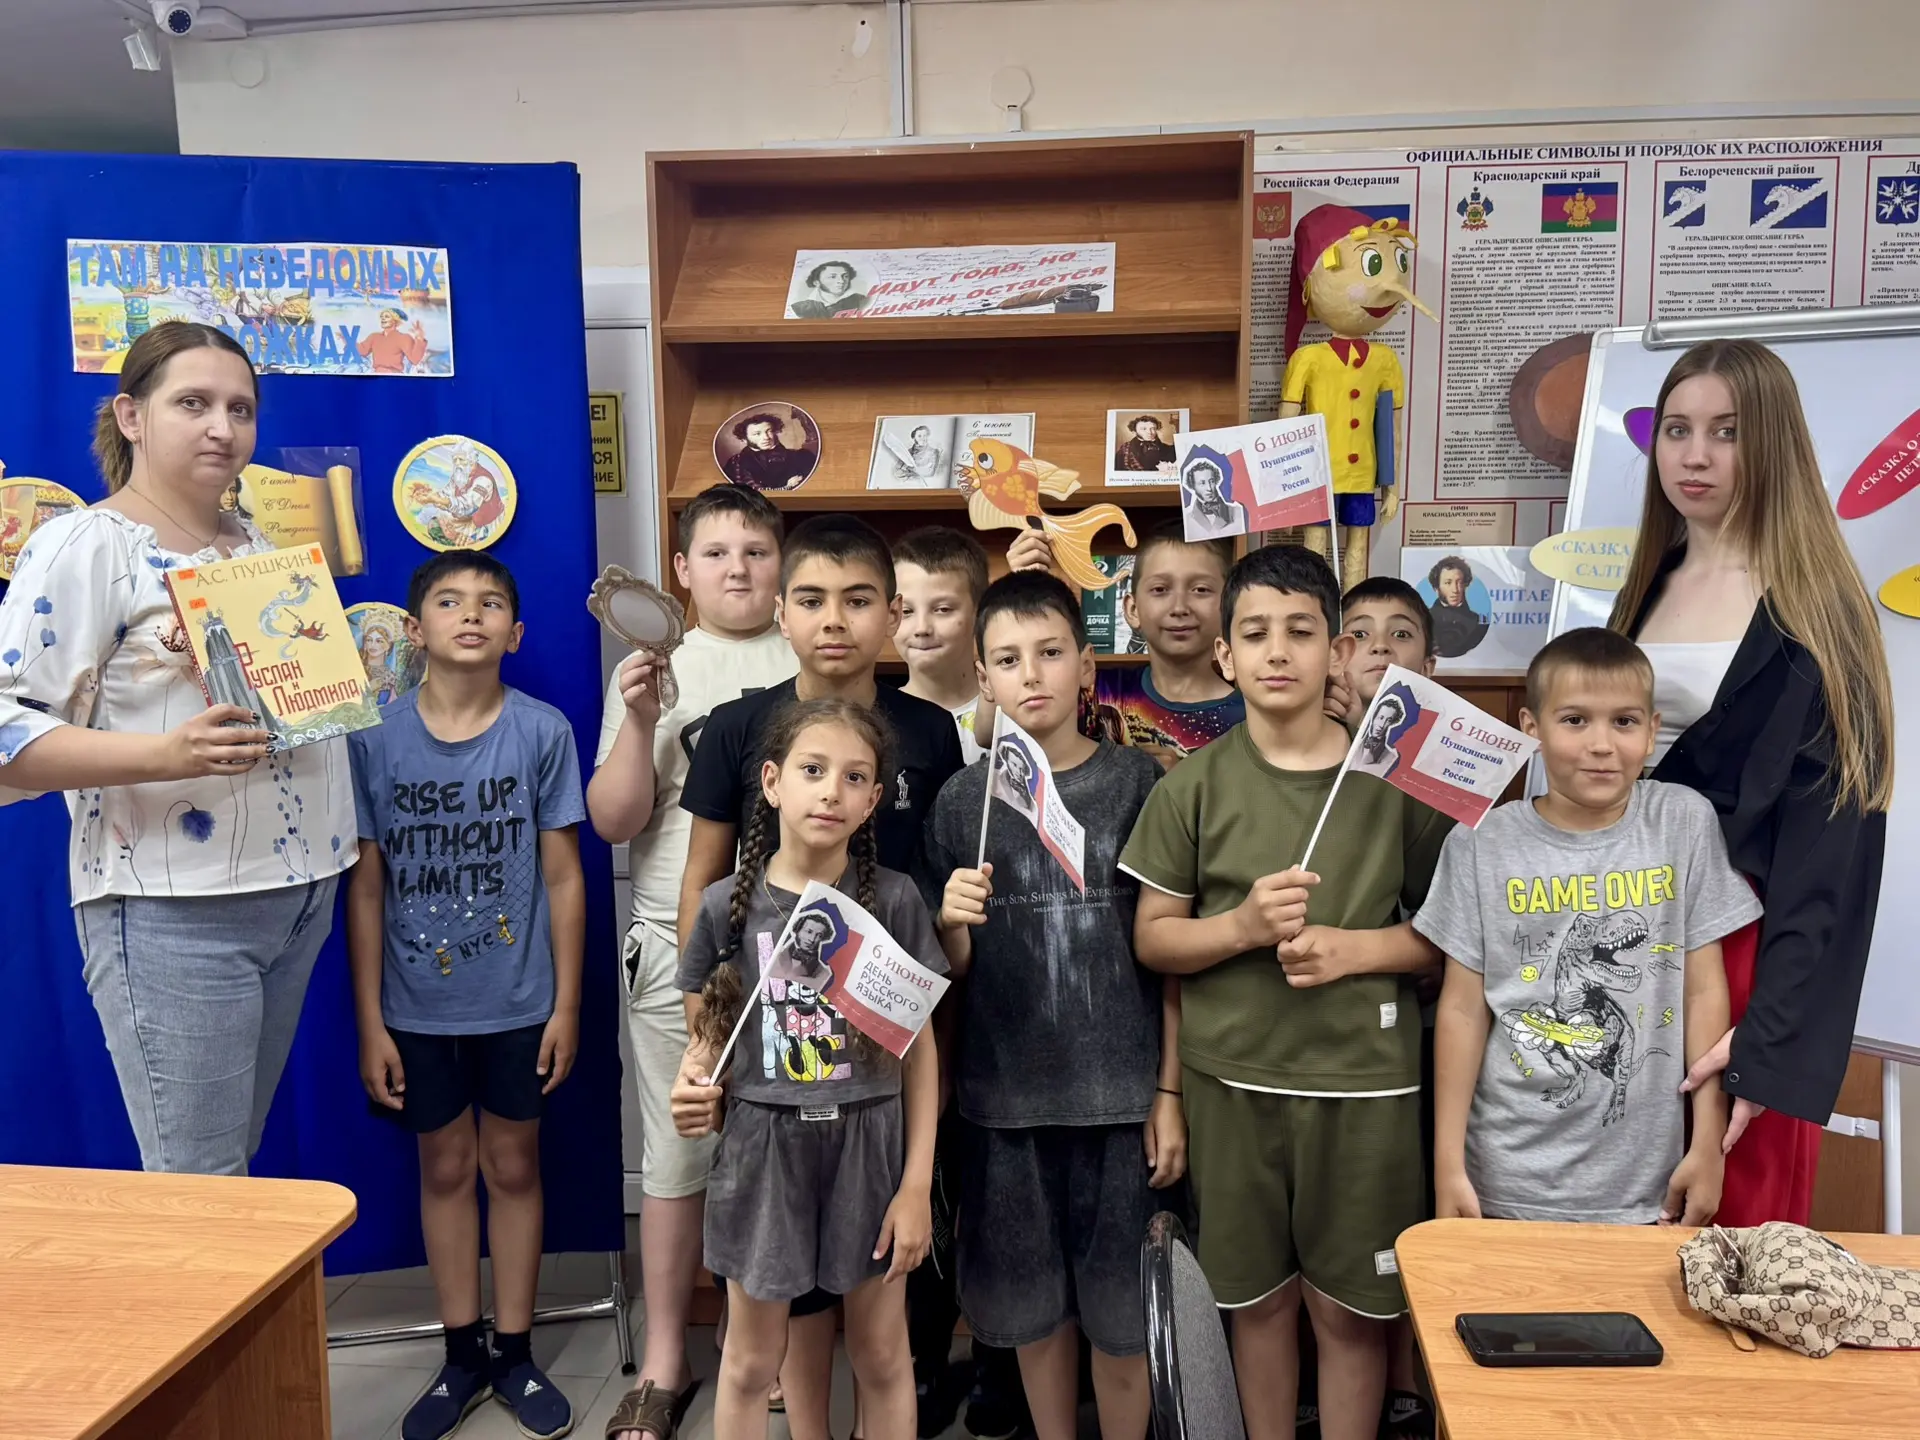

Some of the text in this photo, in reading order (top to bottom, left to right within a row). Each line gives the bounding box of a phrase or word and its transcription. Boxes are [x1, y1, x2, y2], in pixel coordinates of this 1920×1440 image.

[1405, 140, 1883, 164] ОФИЦИАЛЬНЫЕ СИМВОЛЫ И ПОРЯДОК ИХ РАСПОЛОЖЕНИЯ
[1263, 174, 1400, 189] Российская Федерация
[1473, 168, 1601, 184] Краснодарский край
[1679, 164, 1815, 178] Белореченский район
[71, 245, 441, 298] ТАМ НА НЕВЕДОМЫХ
[867, 251, 1077, 297] Идут года, но
[966, 266, 1108, 300] остается
[590, 404, 607, 421] Е!
[1254, 424, 1317, 453] 6 ИЮНЯ
[593, 451, 613, 465] СЯ
[1260, 444, 1315, 470] Пушкинский
[260, 476, 268, 486] 6
[1282, 465, 1303, 477] день
[1895, 457, 1920, 485] ПЕТ
[1281, 477, 1311, 492] России
[196, 551, 313, 588] А.С. ПУШКИН
[1575, 562, 1625, 578] САЛТ
[1489, 588, 1550, 603] ЧИТАЕ
[1478, 612, 1550, 626] ПУШКИ
[1450, 716, 1523, 754] 6 ИЮНЯ
[1439, 735, 1504, 766] Пушкинский
[1442, 767, 1476, 786] России
[1453, 757, 1477, 771] день
[477, 775, 518, 817] UP
[1506, 863, 1675, 914] GAME OVER
[458, 932, 494, 960] NYC
[863, 960, 893, 987] ДЕНЬ
[871, 944, 935, 992] 6 ИЮНЯ
[855, 982, 893, 1013] ЯЗЫКА
[860, 971, 920, 1013] РУССКОГО
[1393, 1397, 1418, 1411] NIKE
